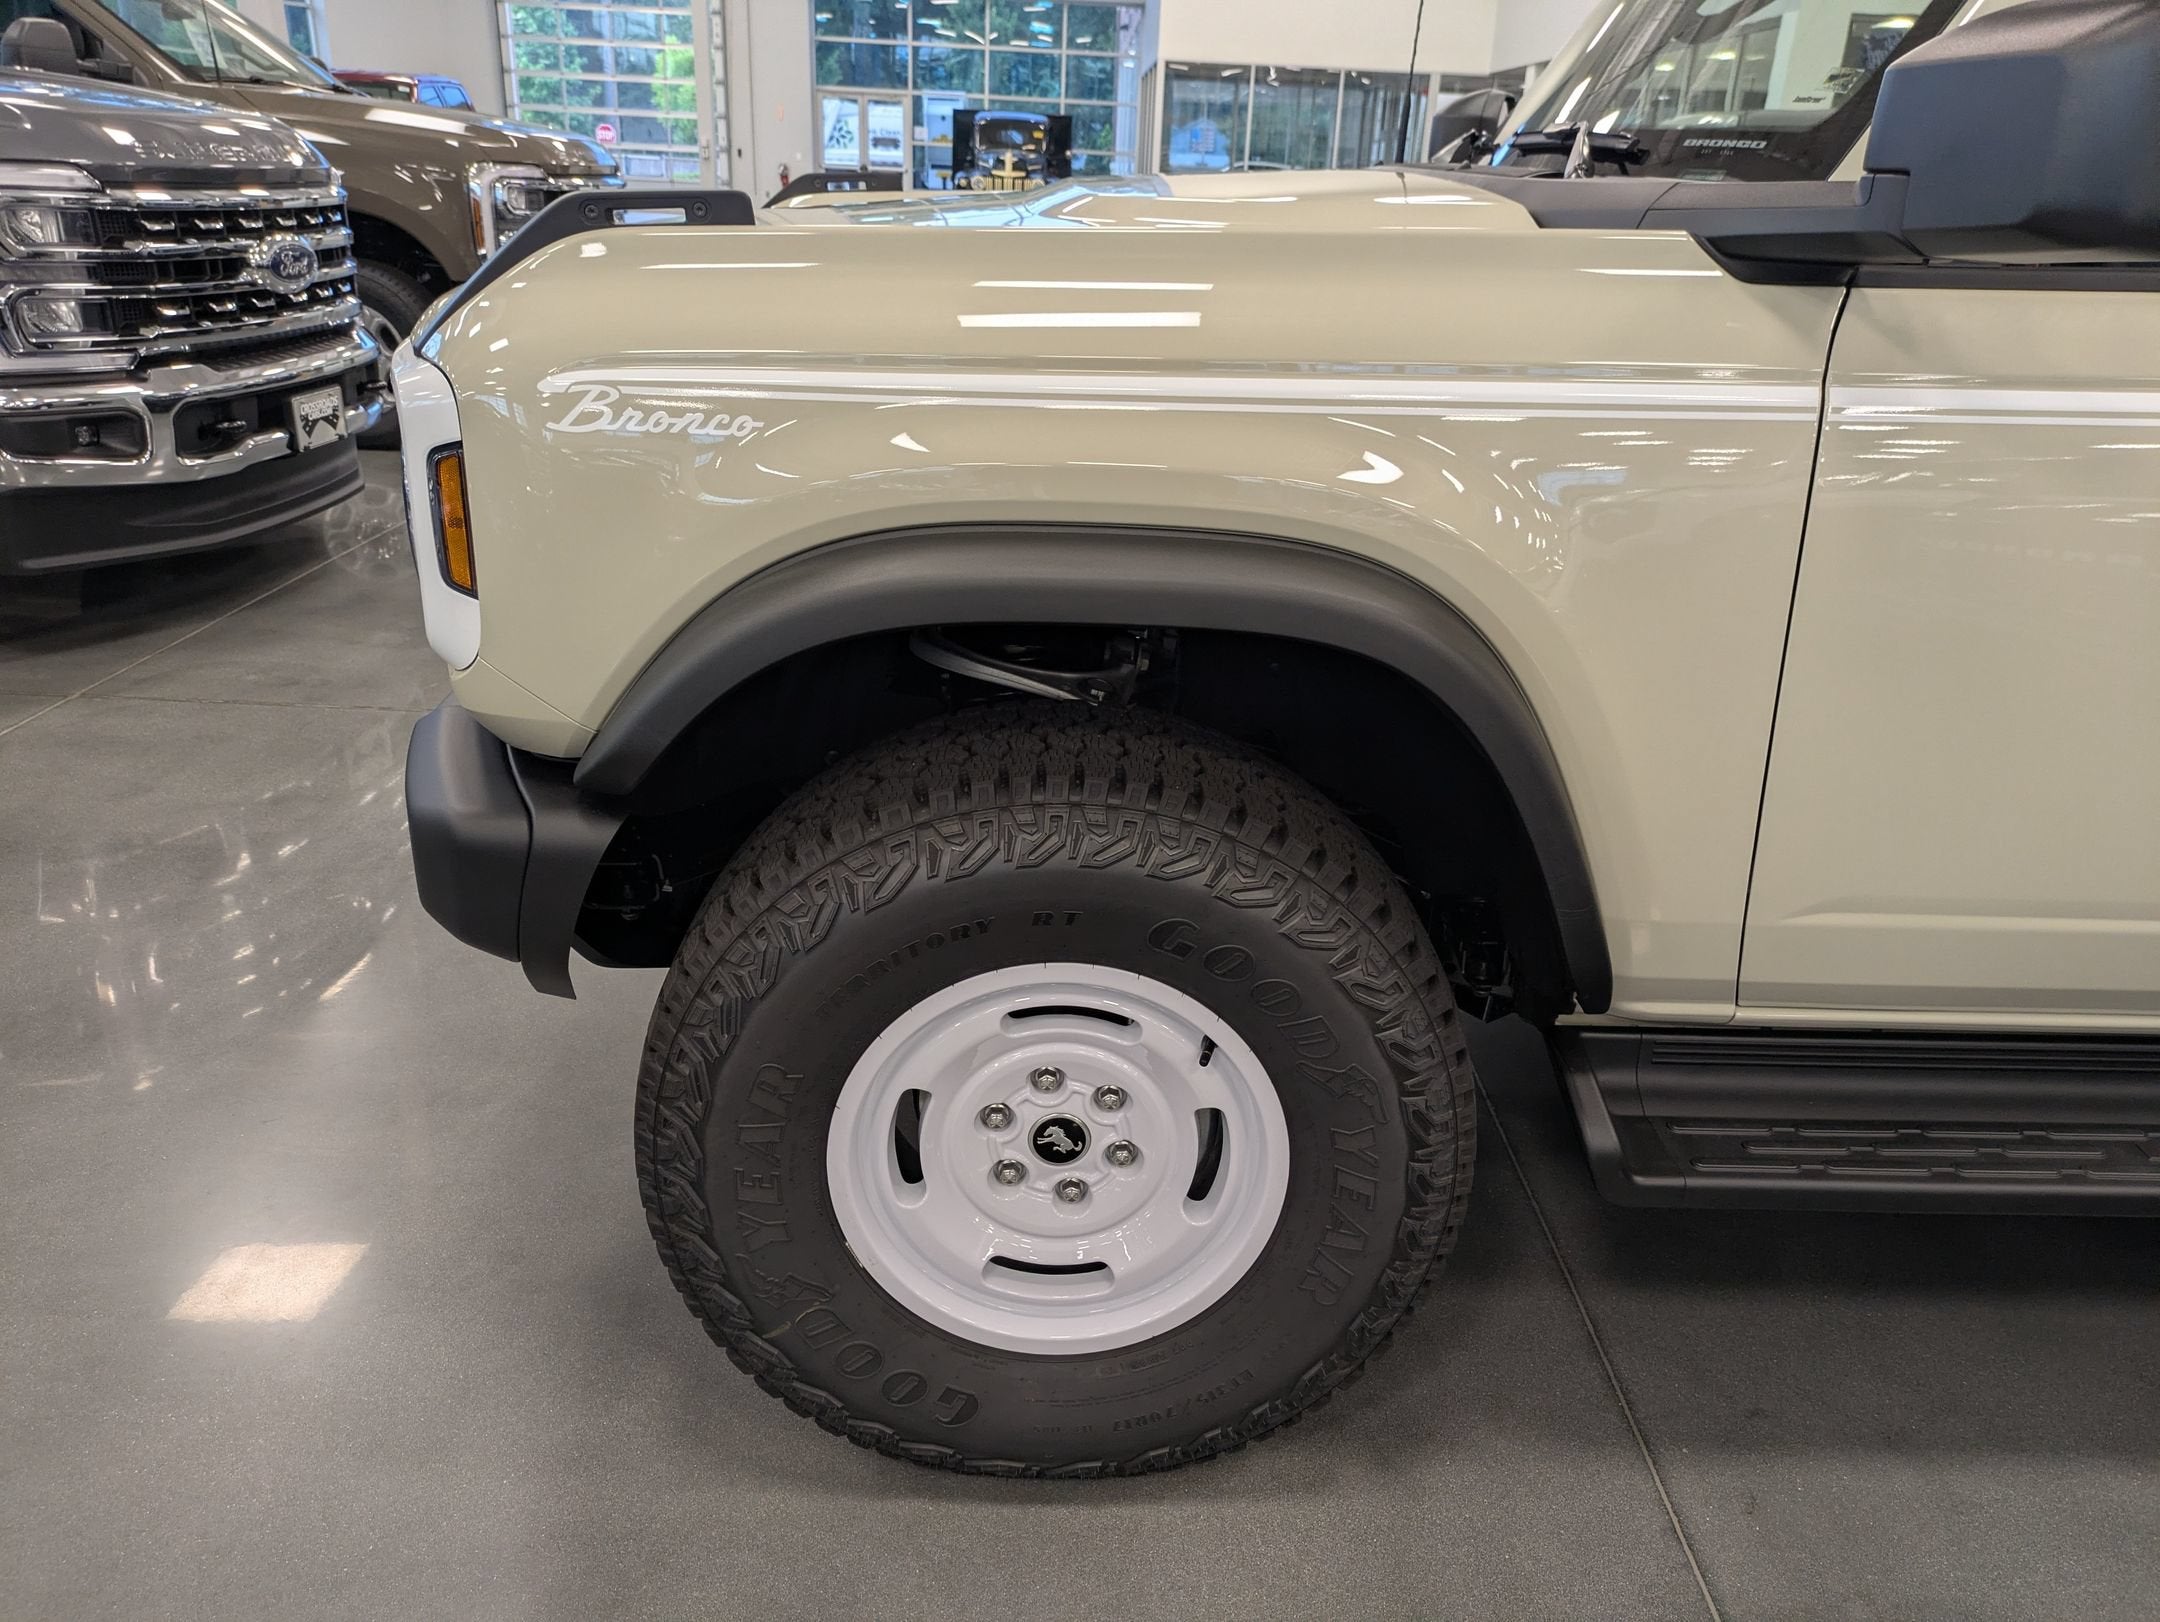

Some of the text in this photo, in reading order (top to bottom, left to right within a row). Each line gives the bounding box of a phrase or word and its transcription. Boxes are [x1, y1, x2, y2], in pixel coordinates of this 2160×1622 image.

[1682, 138, 1768, 149] BRONCO
[280, 250, 310, 277] Ford
[545, 384, 765, 438] Bronco
[1030, 909, 1085, 928] RT
